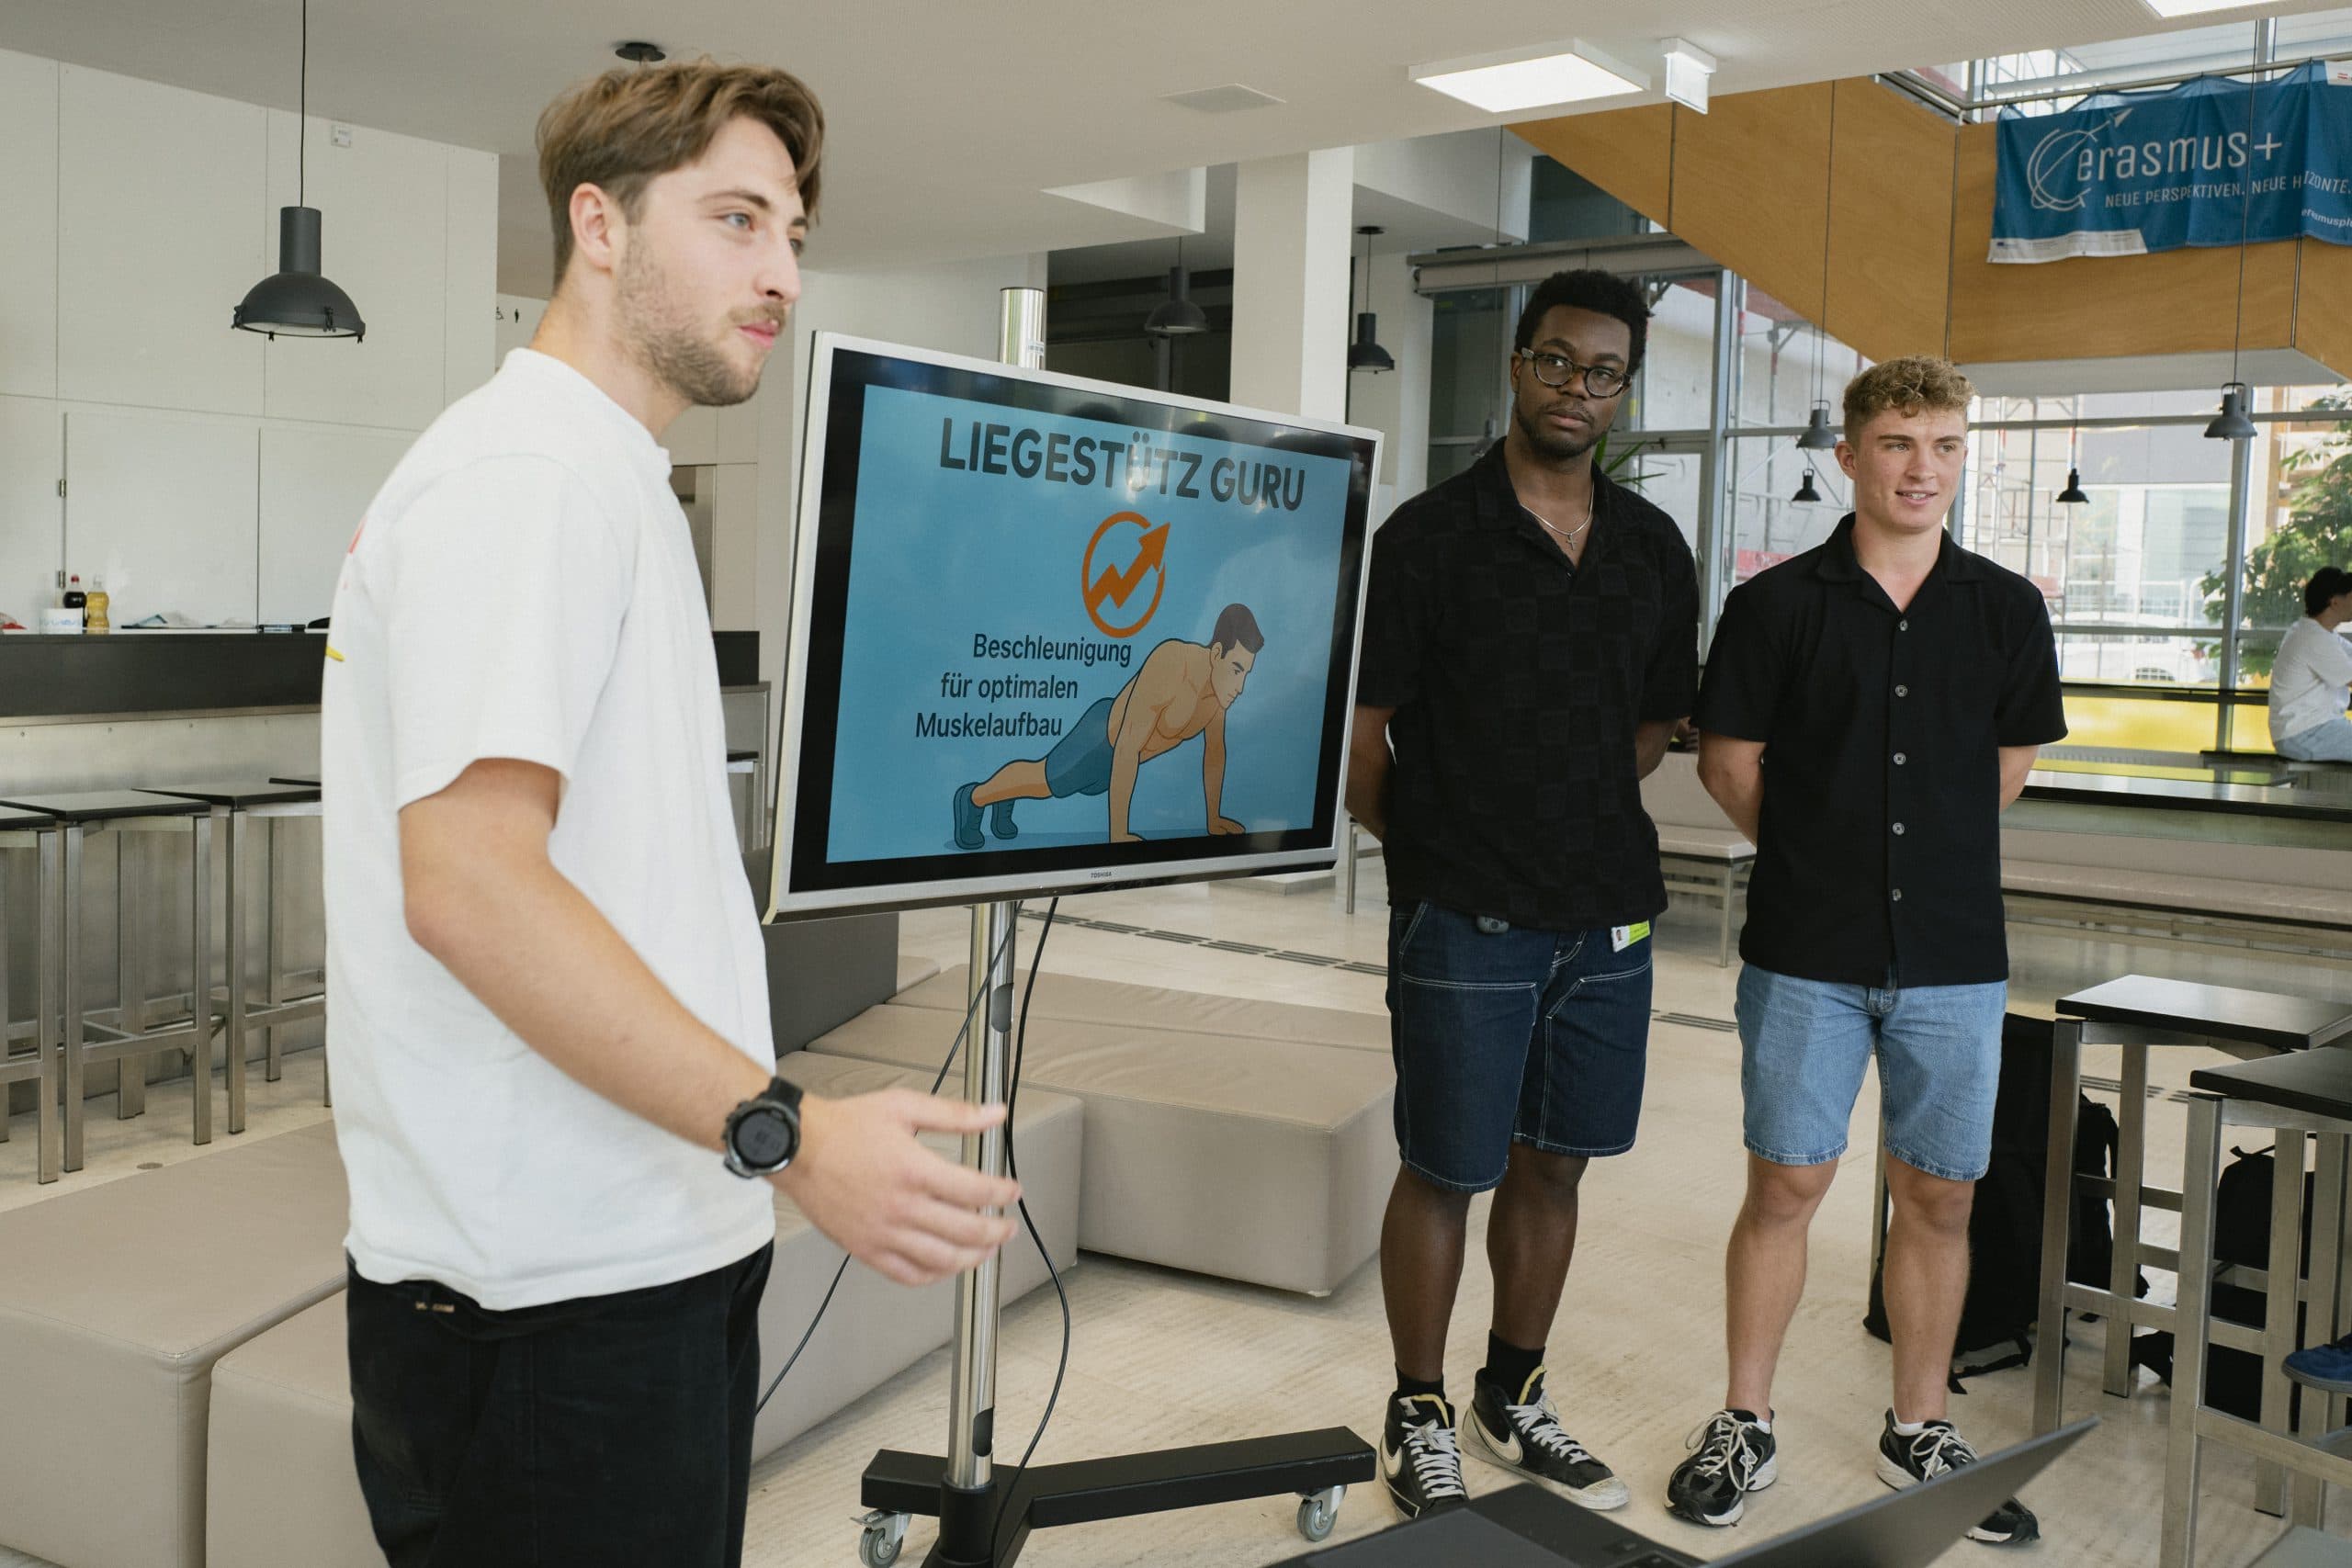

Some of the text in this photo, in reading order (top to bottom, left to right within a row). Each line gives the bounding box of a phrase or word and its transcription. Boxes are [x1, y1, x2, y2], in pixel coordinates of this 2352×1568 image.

[2077, 131, 2282, 182] erasmus+
[2105, 188, 2140, 208] NEUE
[2145, 183, 2245, 205] PERSPEKTIVEN.
[2252, 176, 2287, 195] NEUE
[939, 417, 1306, 512] LIEGESTÜTZ GURU
[973, 633, 1132, 668] Beschleunigung
[941, 671, 1080, 703] für optimalen
[916, 712, 1062, 739] Muskelaufbau
